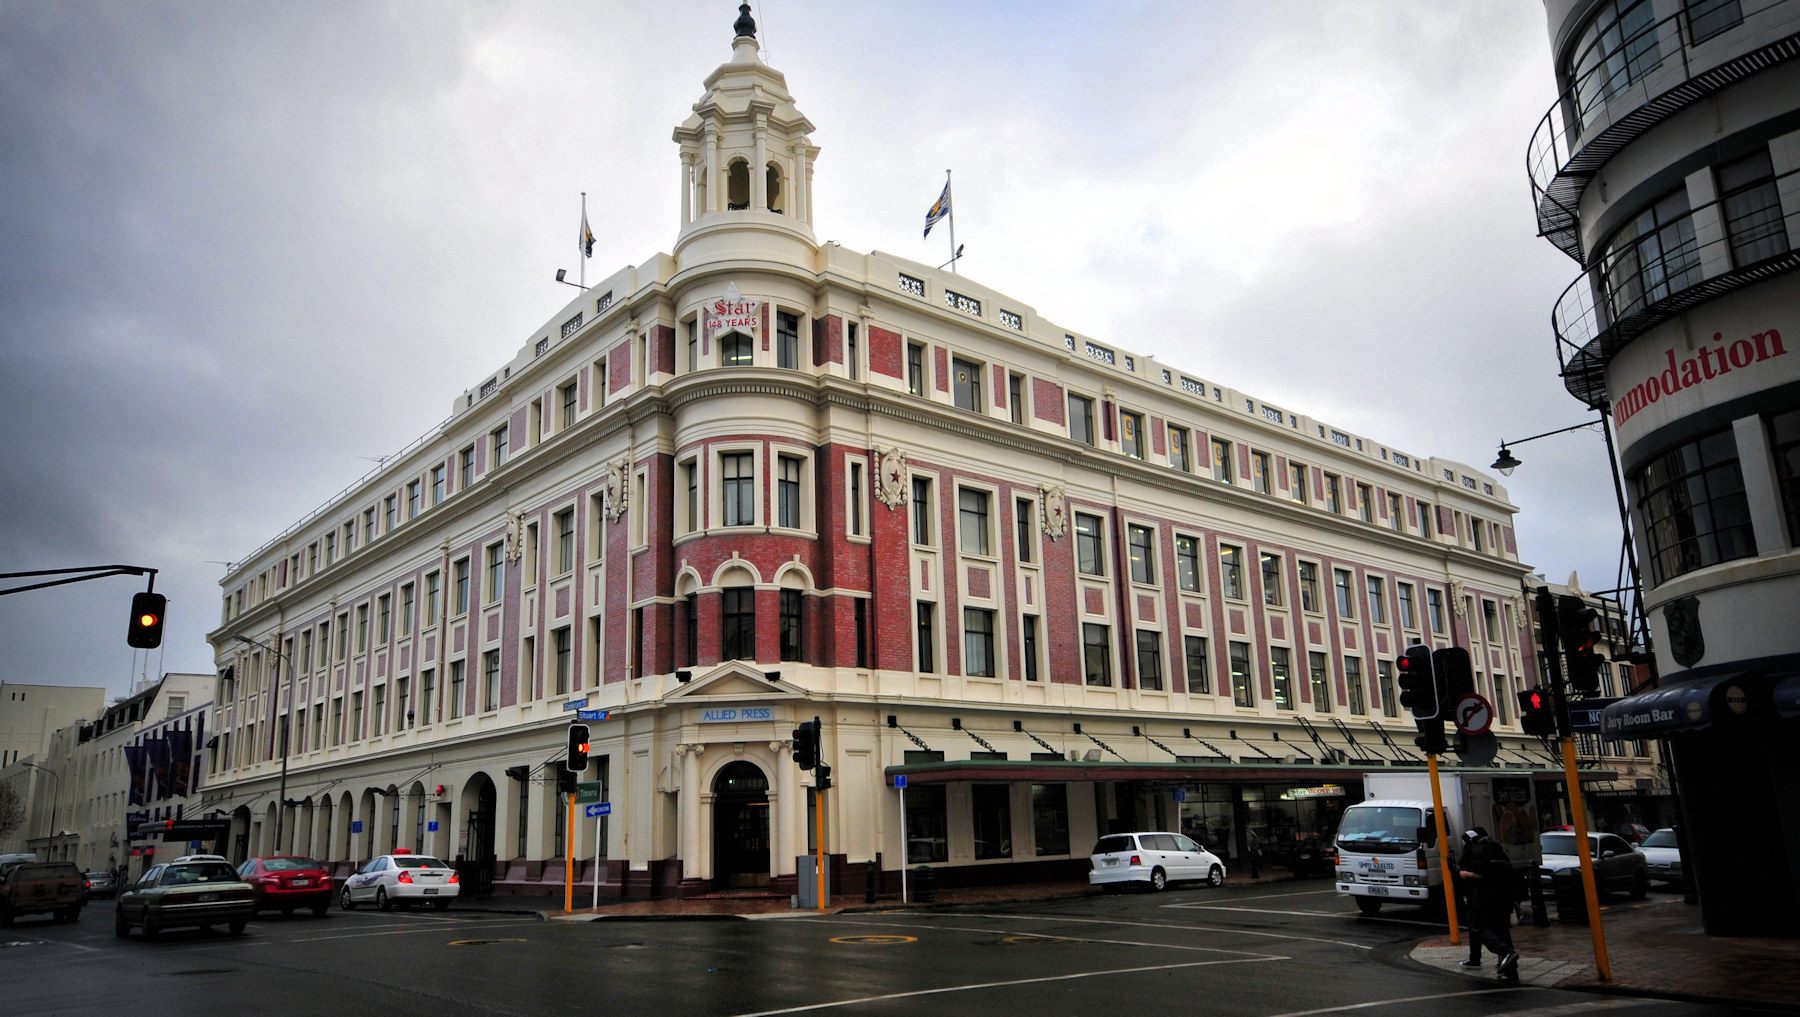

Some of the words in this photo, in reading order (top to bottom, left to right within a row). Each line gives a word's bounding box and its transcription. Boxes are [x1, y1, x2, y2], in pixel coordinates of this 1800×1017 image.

[715, 299, 755, 316] Star
[726, 318, 757, 327] YEARS
[578, 711, 596, 720] Stuart
[598, 711, 605, 720] St
[704, 709, 737, 720] ALLIED
[741, 708, 770, 719] PRESS
[1607, 716, 1622, 730] Jury
[1623, 713, 1651, 726] Room
[1651, 709, 1674, 722] Bar
[580, 789, 598, 798] Timaru
